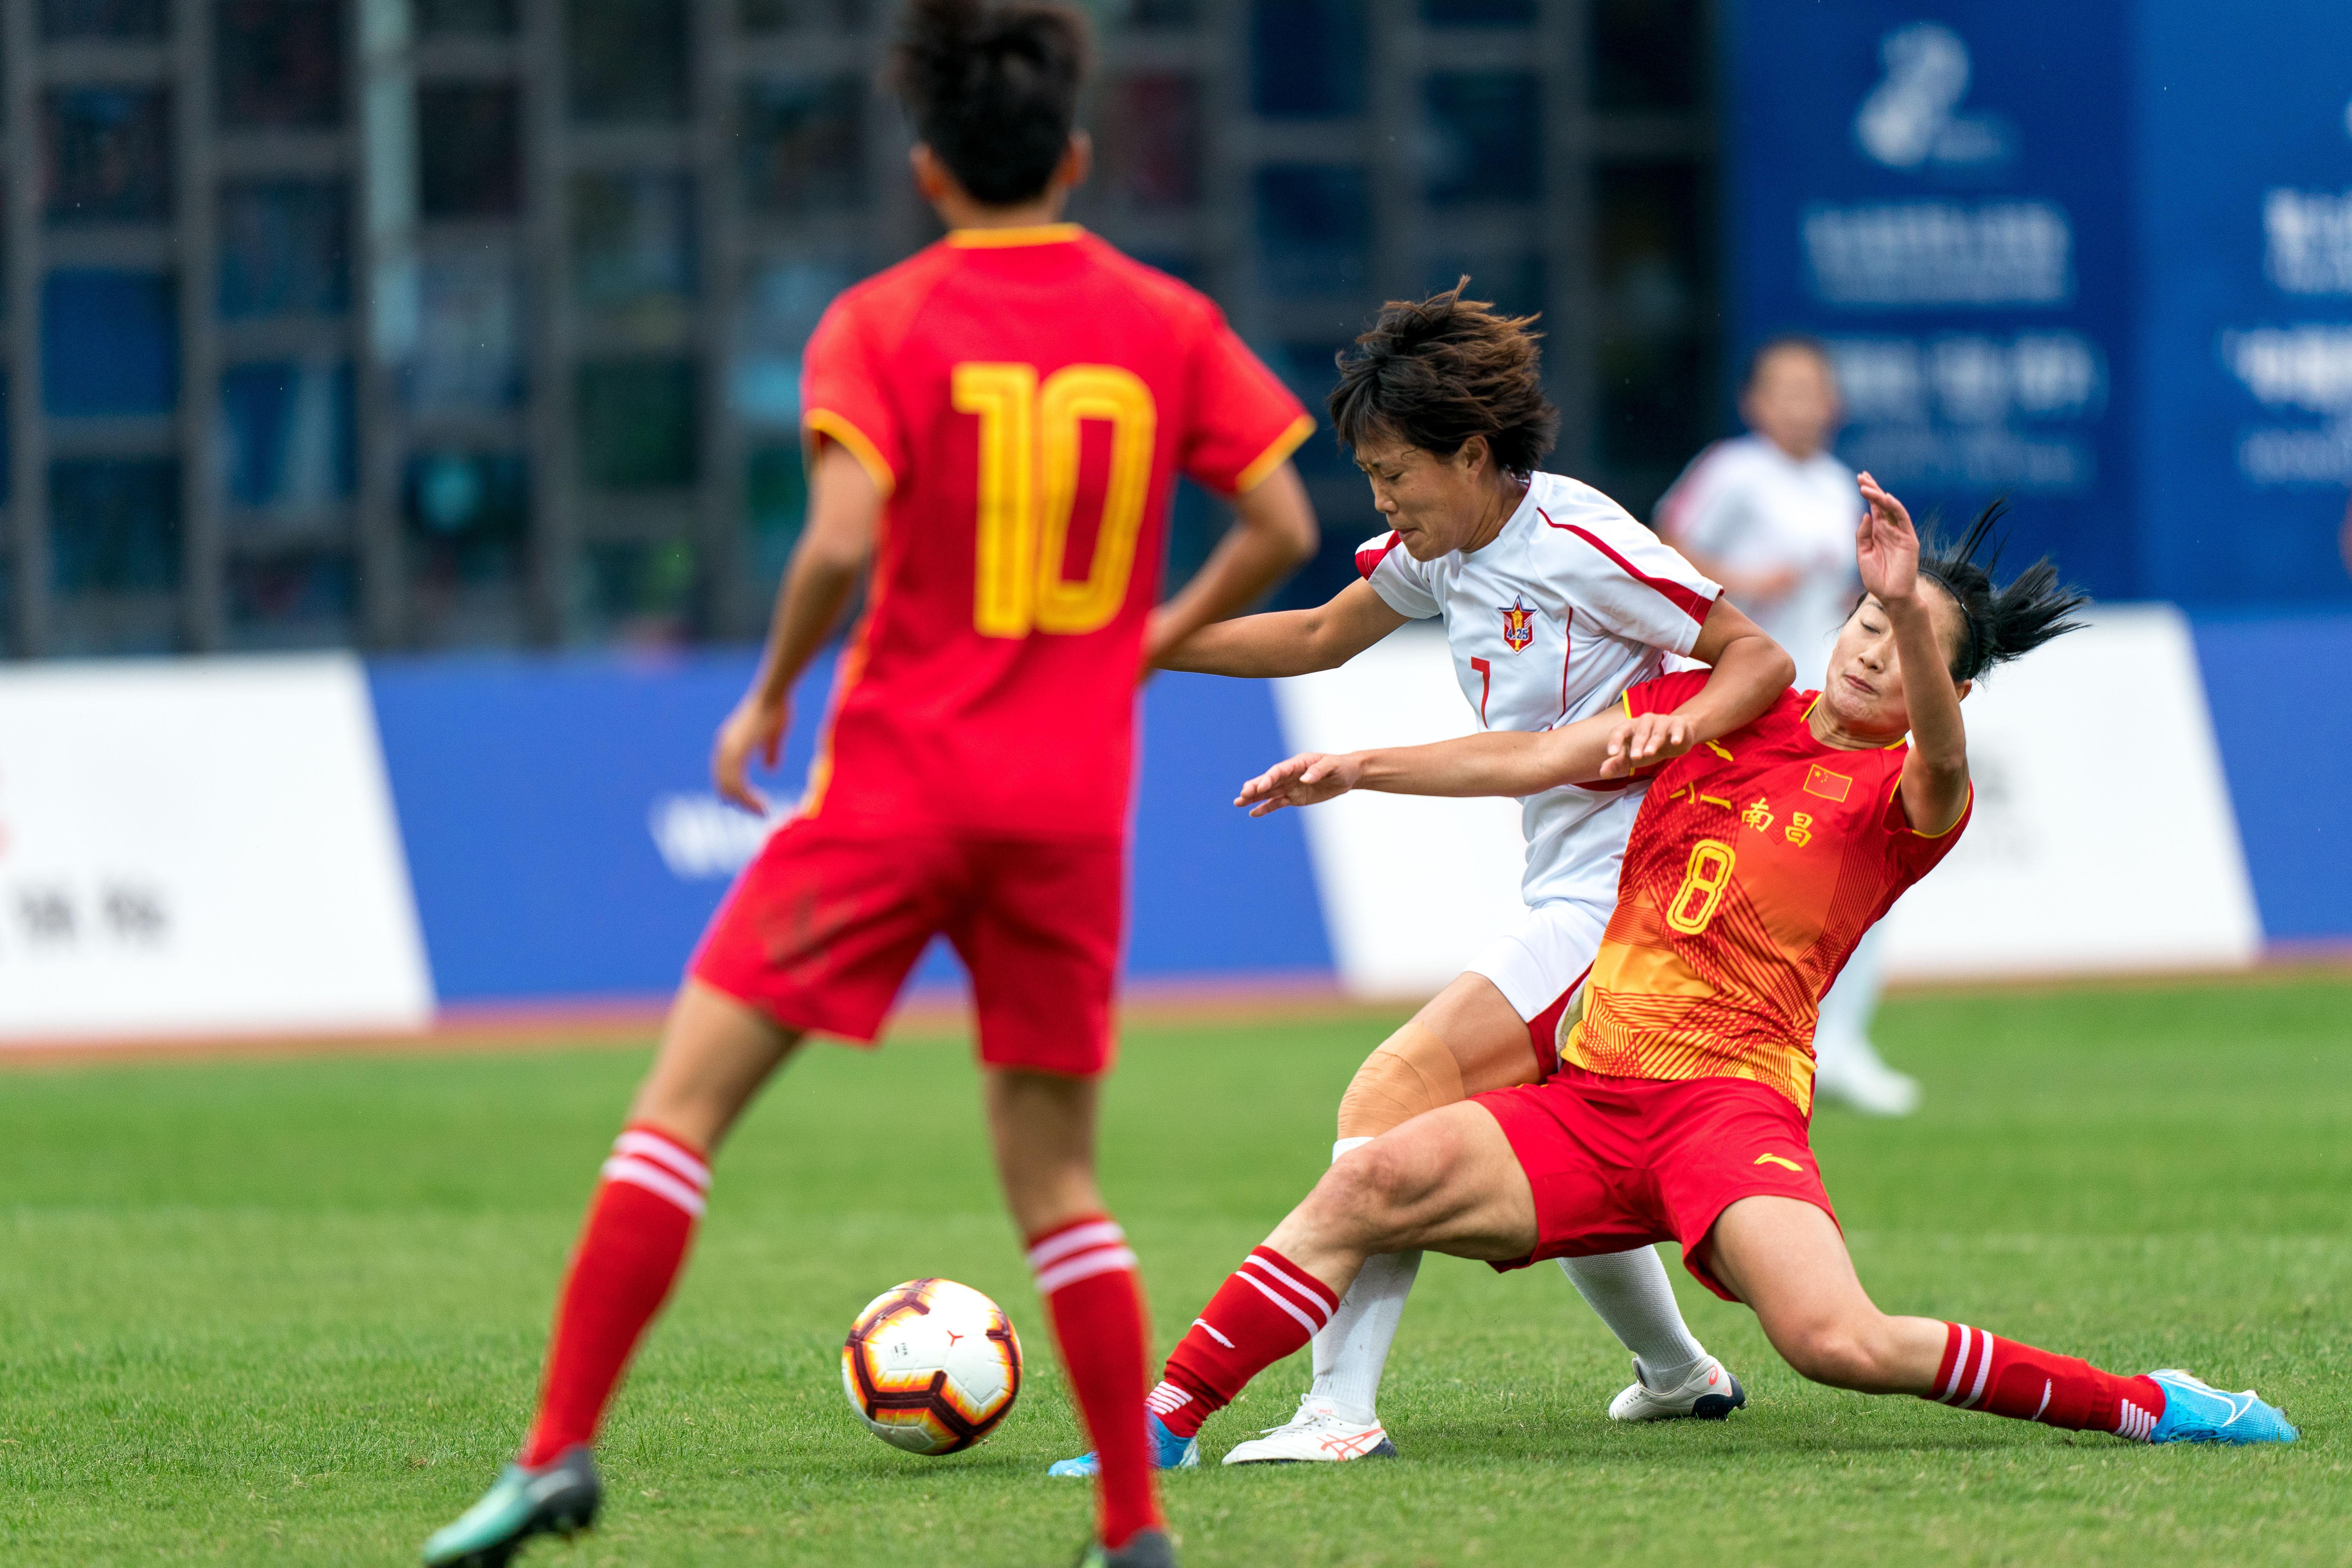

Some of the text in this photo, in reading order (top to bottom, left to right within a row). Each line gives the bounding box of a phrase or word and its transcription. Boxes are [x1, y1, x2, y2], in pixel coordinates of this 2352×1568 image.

[951, 361, 1157, 639] 10
[1507, 628, 1528, 640] 4.25
[1471, 656, 1490, 729] 7
[1670, 781, 1813, 848] 八一南昌
[1666, 839, 1736, 935] 8
